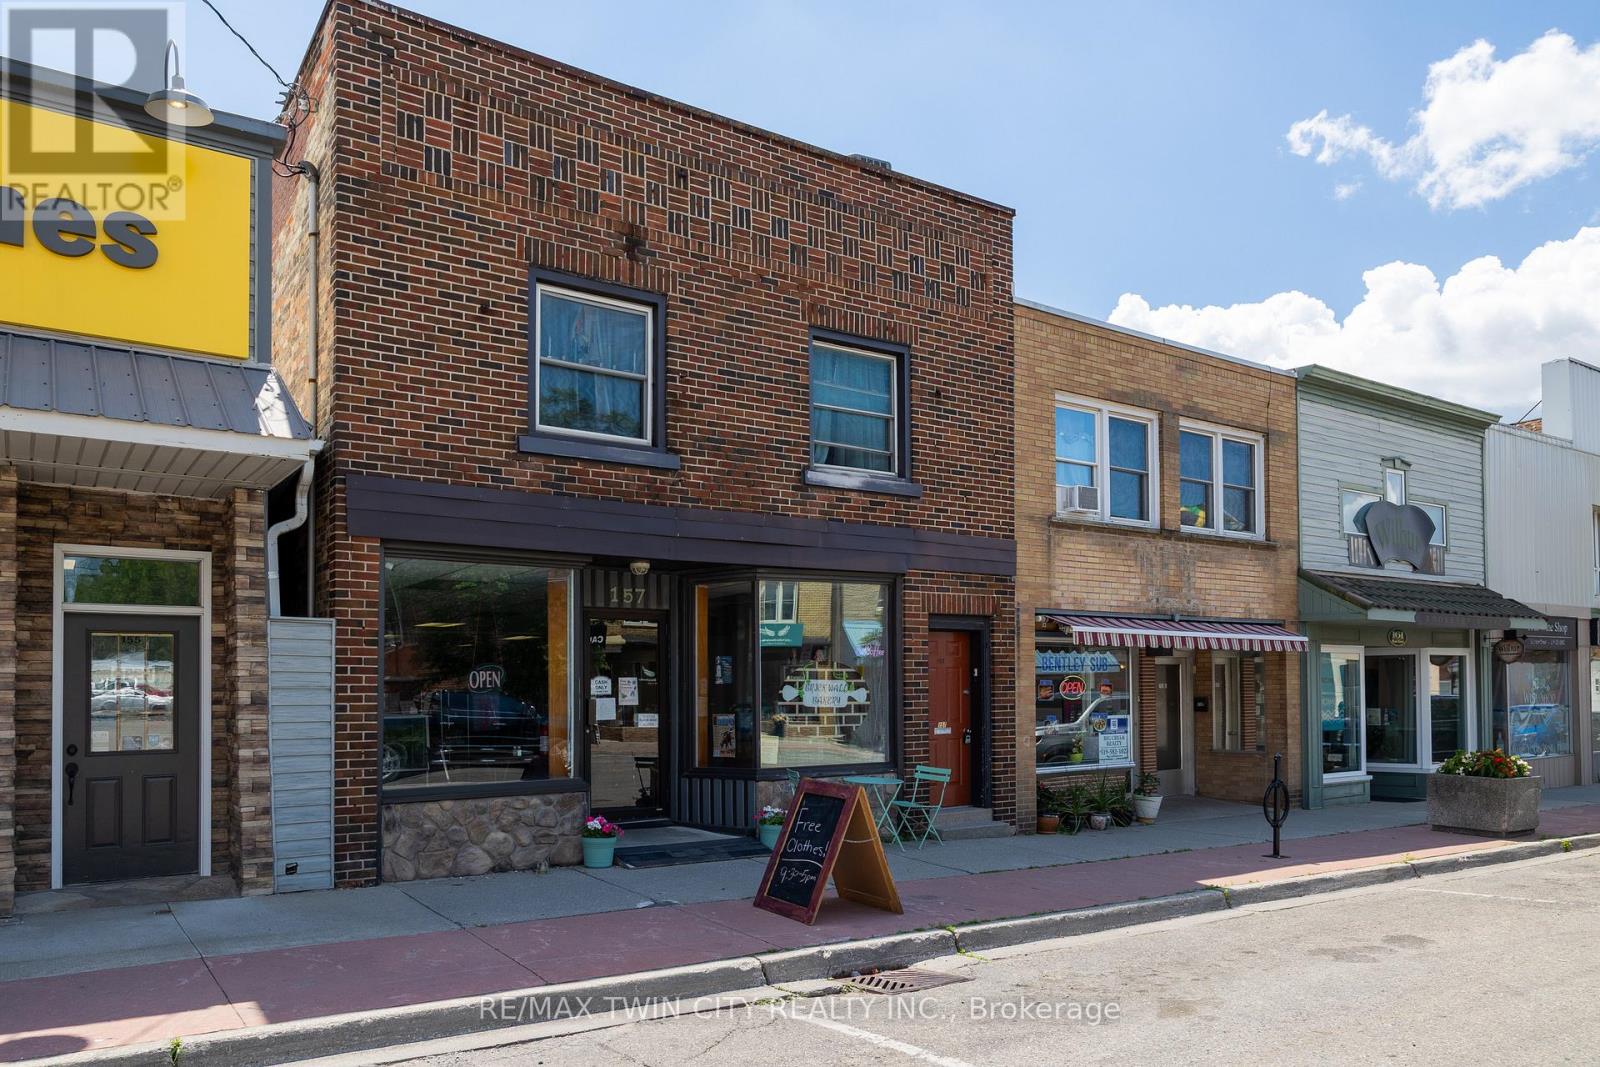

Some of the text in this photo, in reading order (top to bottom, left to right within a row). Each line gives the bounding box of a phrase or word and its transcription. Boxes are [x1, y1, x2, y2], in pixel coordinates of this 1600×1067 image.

[609, 586, 646, 604] 157
[1042, 657, 1108, 671] BENTLEY SUB
[469, 670, 501, 689] OPEN
[1062, 682, 1084, 694] OPEN
[794, 807, 821, 832] Free
[786, 837, 829, 858] Clothes!
